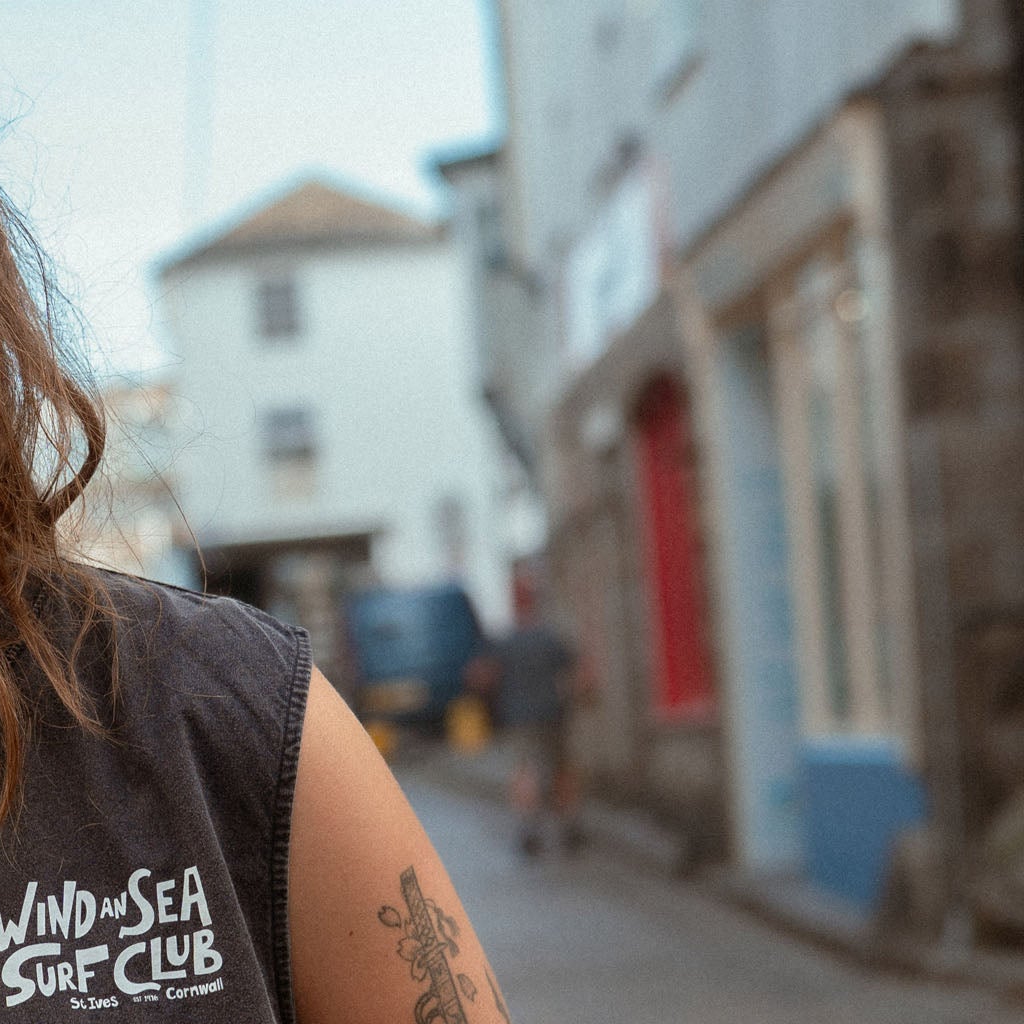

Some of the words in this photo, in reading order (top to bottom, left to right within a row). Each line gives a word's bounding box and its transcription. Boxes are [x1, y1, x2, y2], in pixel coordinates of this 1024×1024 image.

[100, 891, 127, 919] AN
[118, 865, 212, 939] SEA
[1, 942, 109, 1007] SURF
[113, 928, 223, 995] CLUB
[166, 977, 224, 1000] Cornwall
